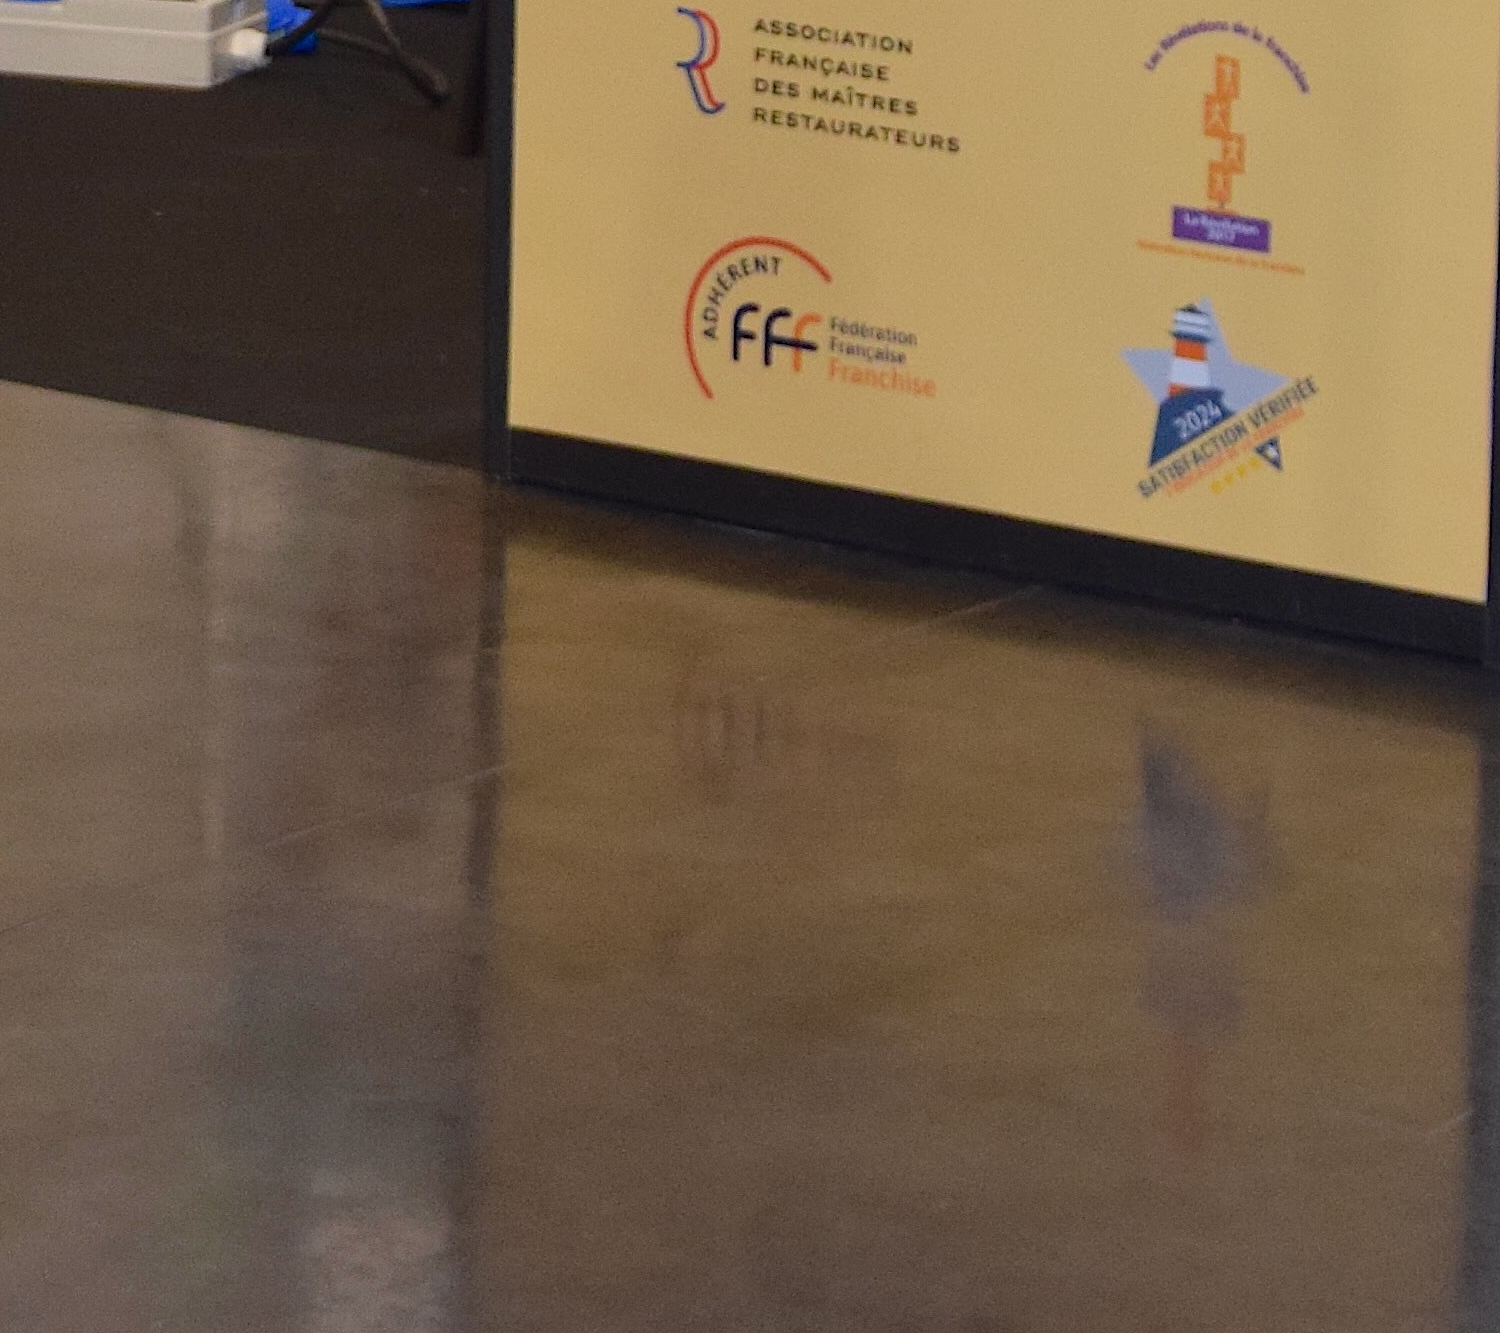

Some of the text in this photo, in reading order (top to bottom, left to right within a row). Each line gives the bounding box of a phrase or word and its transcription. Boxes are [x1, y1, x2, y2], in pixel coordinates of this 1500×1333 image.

[753, 17, 914, 55] ASSOCIATION
[754, 47, 891, 82] FRANÇAISE
[754, 77, 919, 117] DES MAÎTRES
[752, 108, 962, 155] RESTAURATEURS
[702, 254, 784, 341] ADHÉRENT
[828, 335, 908, 365] Française
[829, 316, 919, 347] Fédération
[827, 356, 937, 398] Franchise
[1173, 399, 1224, 440] 2024
[1137, 419, 1250, 498] SATISFACTION
